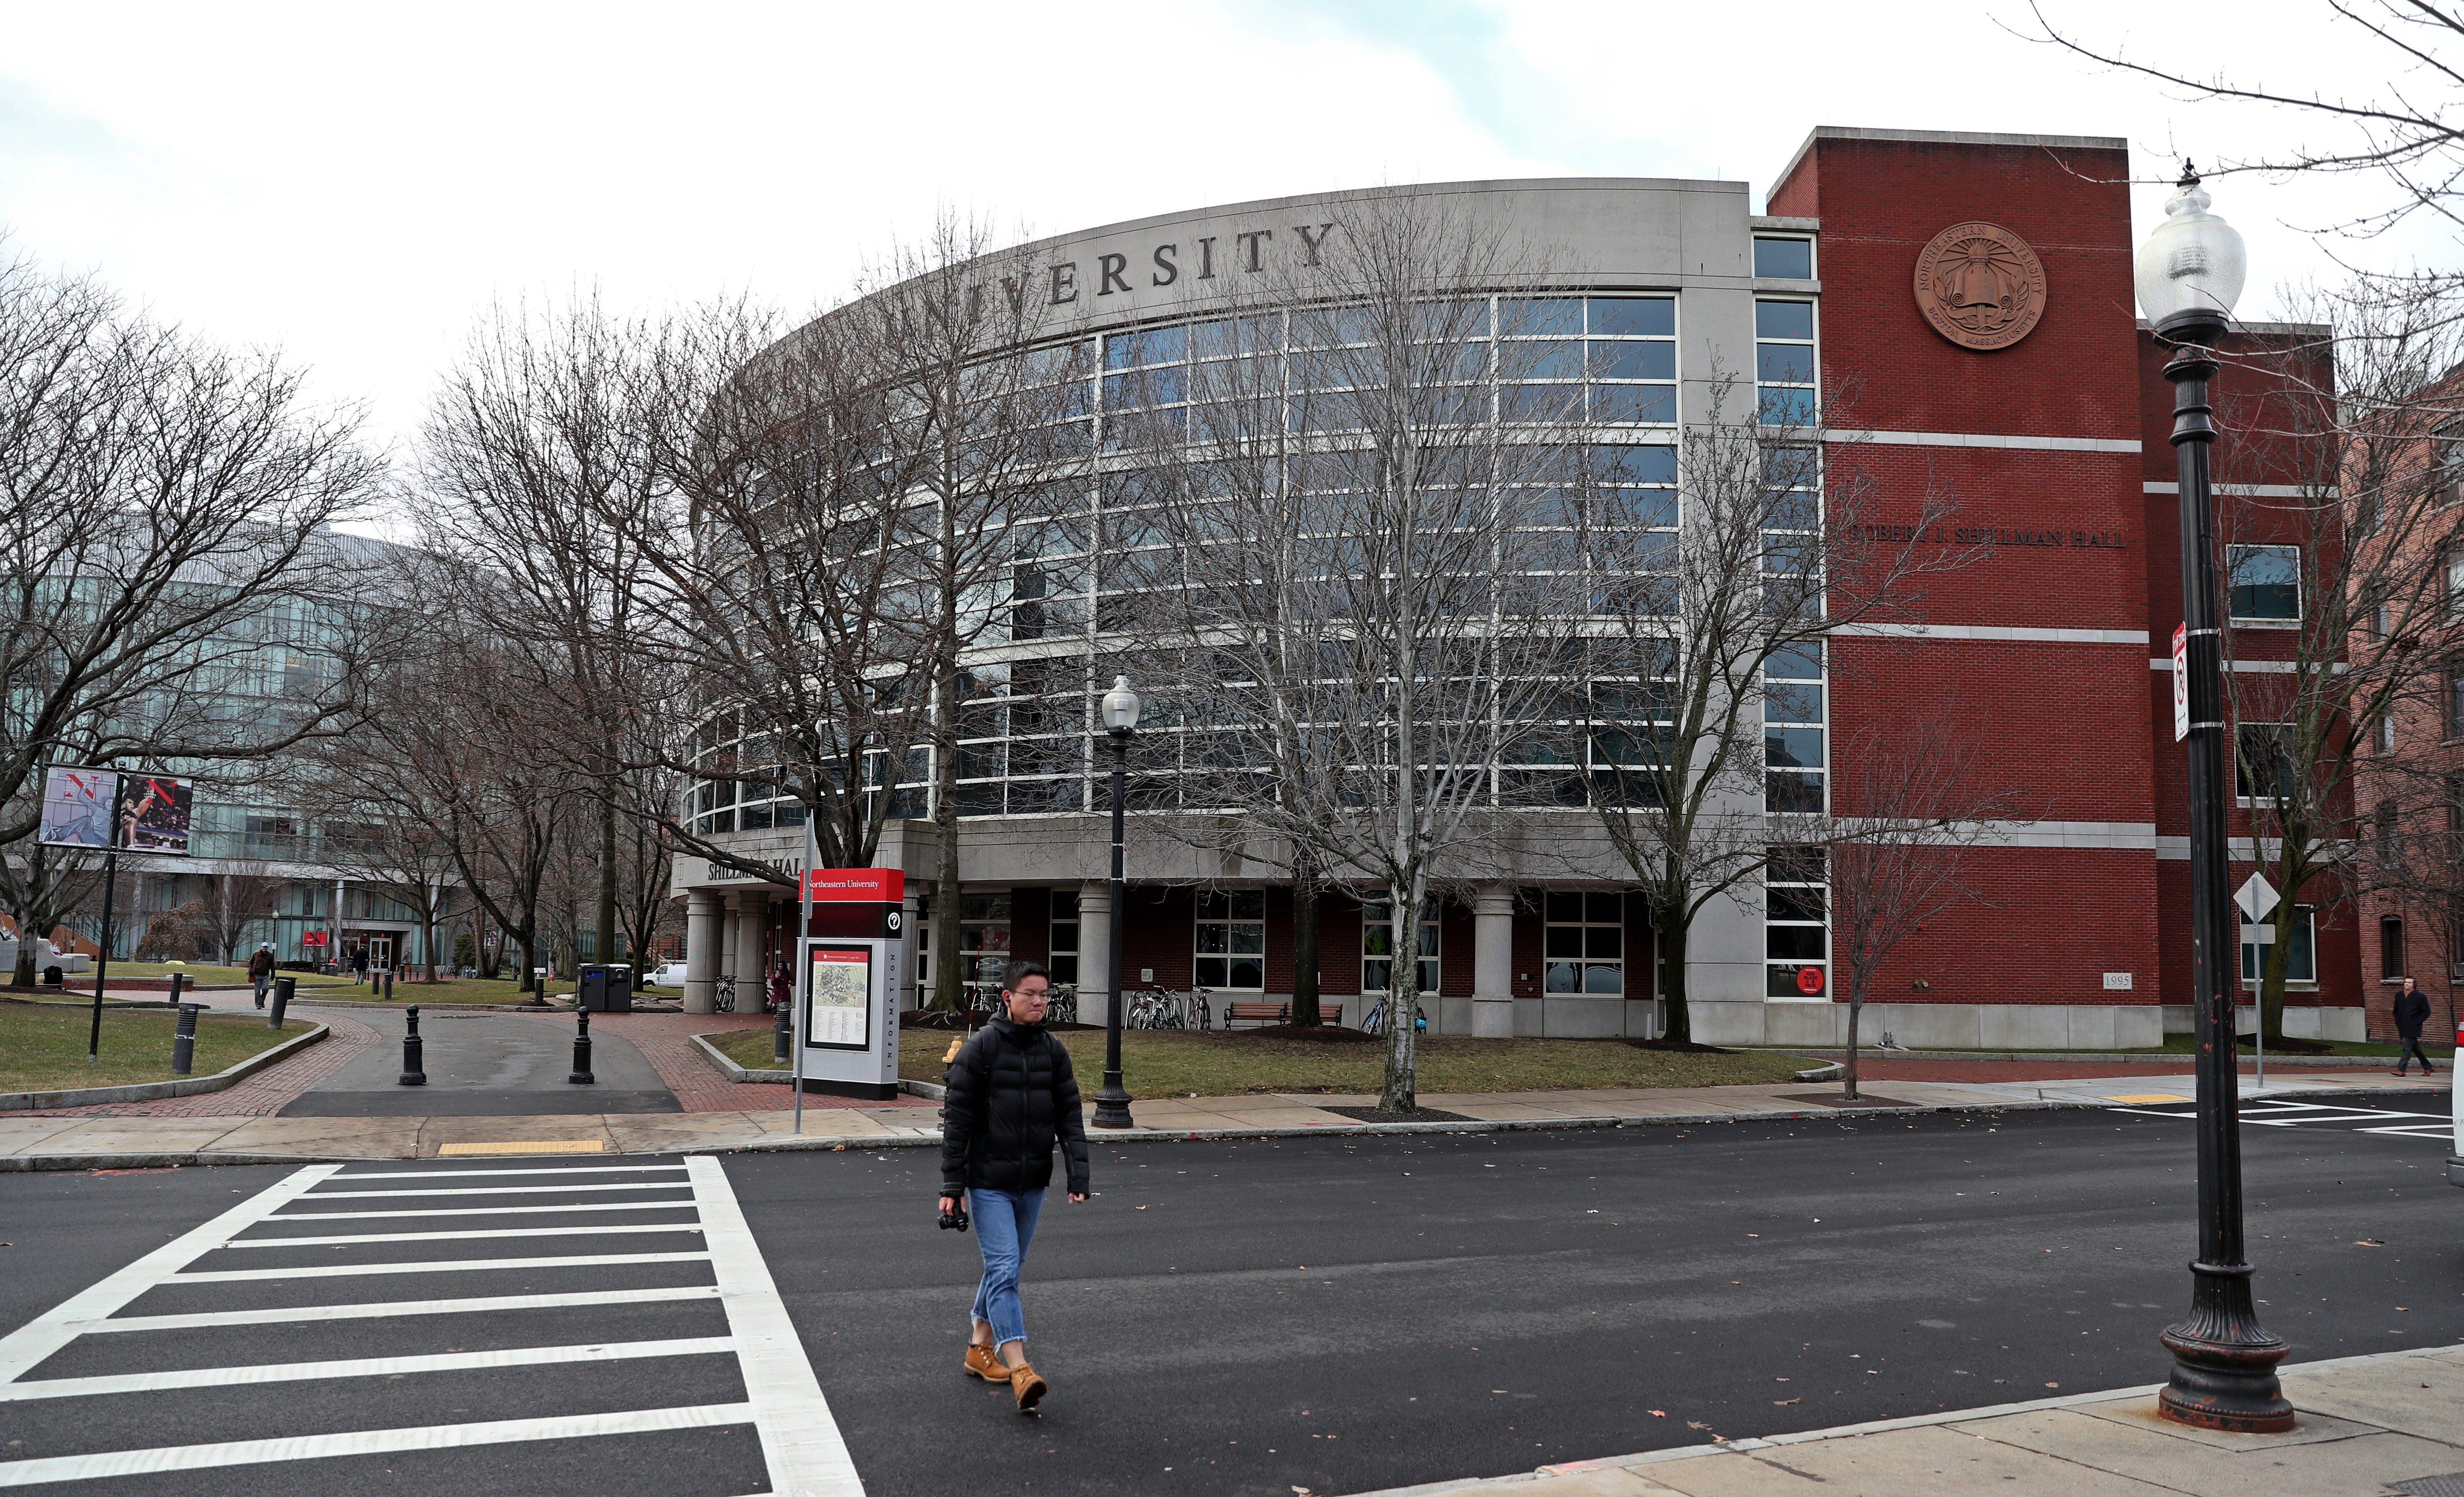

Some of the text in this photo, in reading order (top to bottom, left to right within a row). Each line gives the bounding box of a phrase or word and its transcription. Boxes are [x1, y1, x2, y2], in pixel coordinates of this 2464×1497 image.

[1920, 225, 2043, 295] NORTHEASTERN UNIVERSITY
[883, 222, 1333, 347] NIVERSITY
[1927, 306, 2036, 345] BOSTON, MASSACHUSETTS
[1849, 524, 2127, 548] ROBERT J. SHILLMAN HALL
[708, 857, 805, 880] SHILL HAL
[847, 880, 879, 889] University
[2106, 976, 2129, 985] 1995
[887, 954, 895, 1068] INFORMATION
